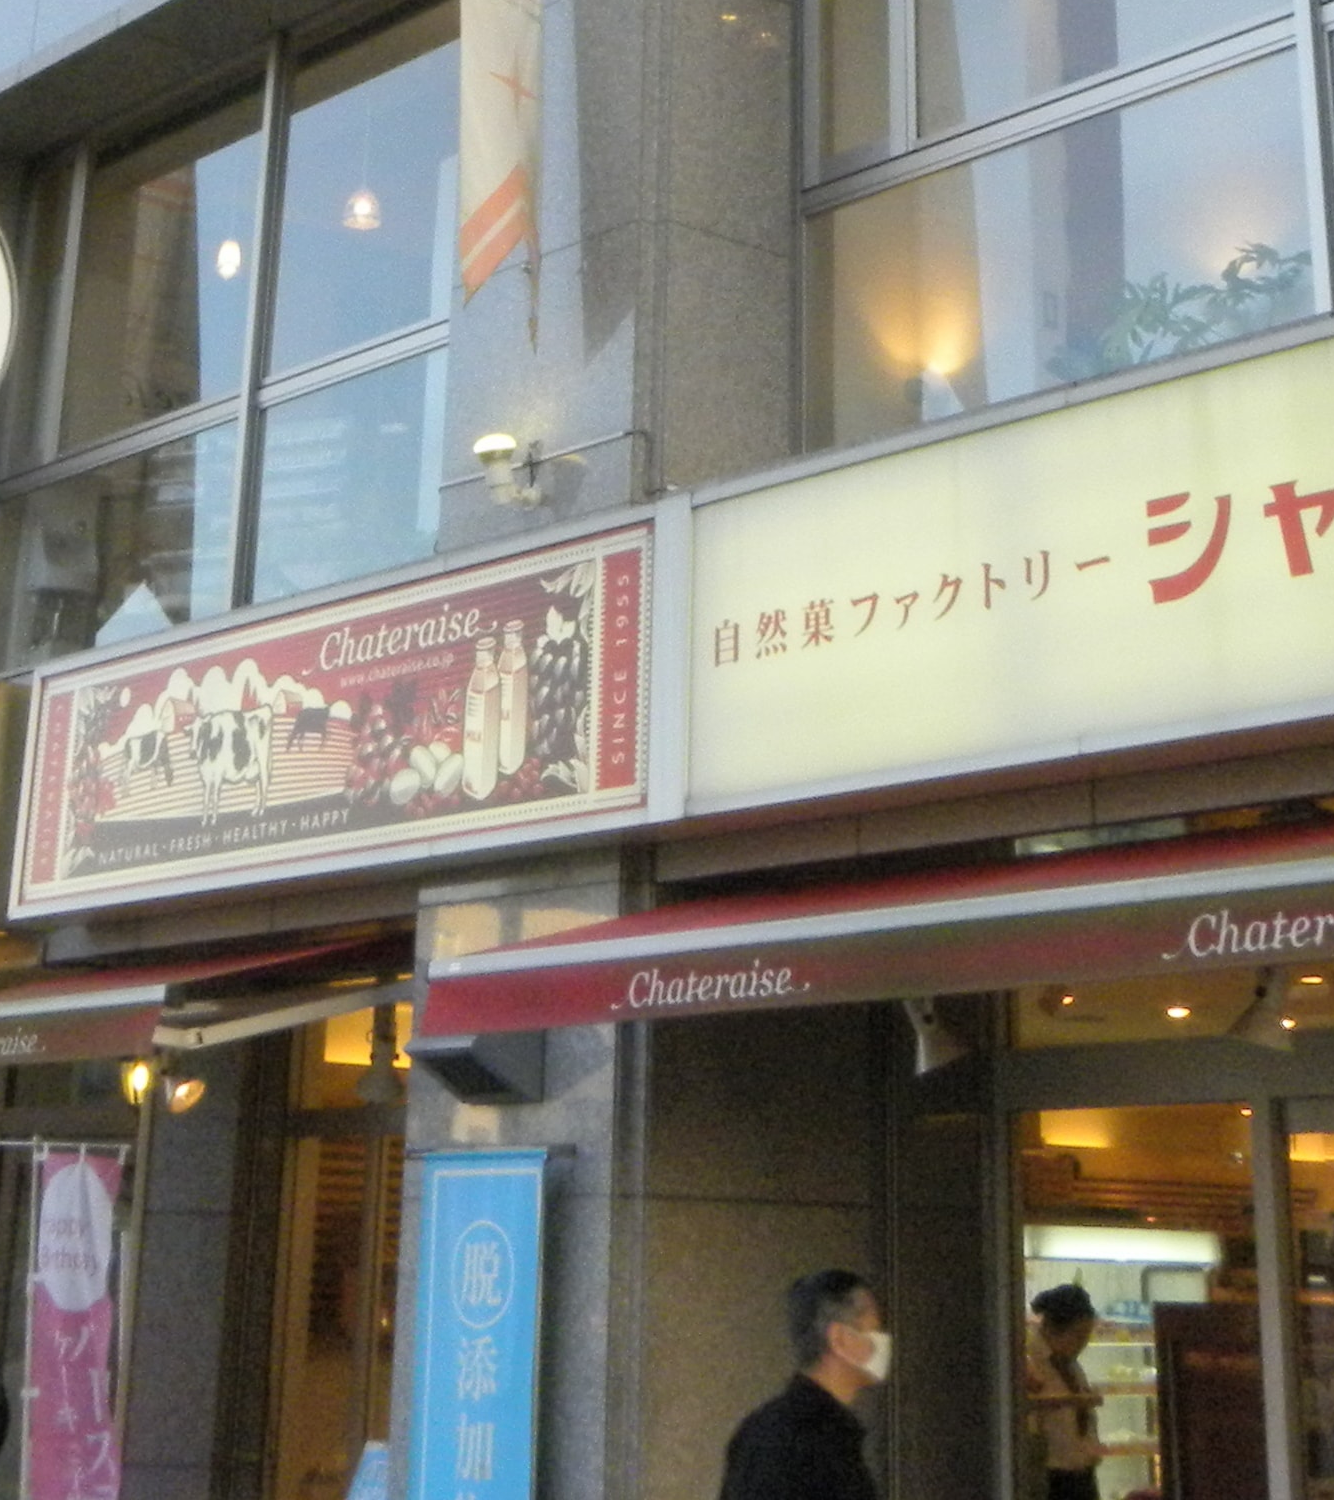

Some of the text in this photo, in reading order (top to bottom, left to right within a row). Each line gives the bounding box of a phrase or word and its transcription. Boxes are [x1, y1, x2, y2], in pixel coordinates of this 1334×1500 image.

[317, 602, 481, 672] Chateraise
[712, 550, 1113, 668] 自然菓ファクトリー
[610, 574, 630, 765] SINCE 1955
[97, 807, 351, 866] NATURAL FRESH HEALTHY HAPPY
[626, 957, 794, 1009] Chateraise
[455, 1242, 503, 1500] 脱添加
